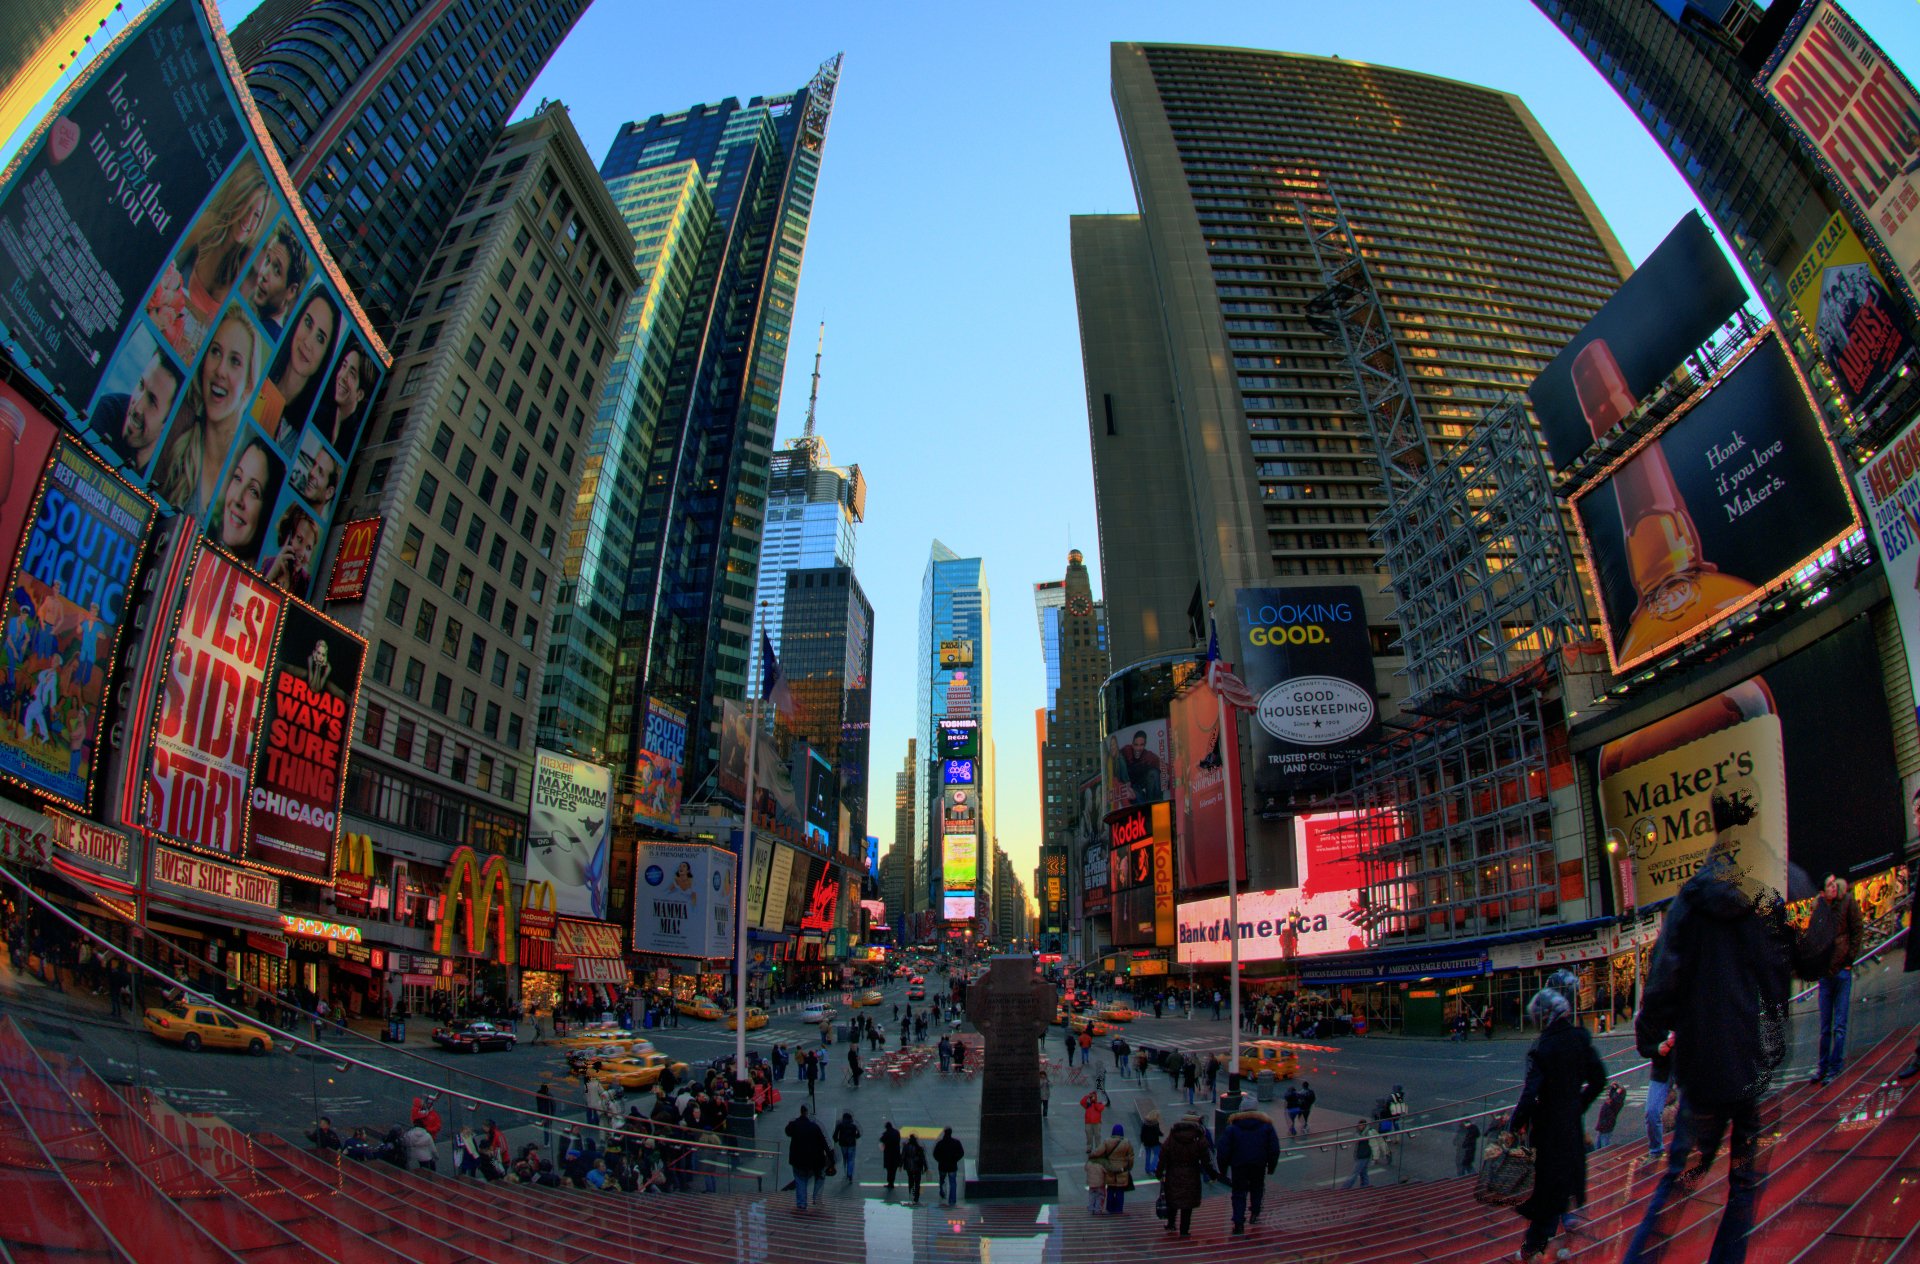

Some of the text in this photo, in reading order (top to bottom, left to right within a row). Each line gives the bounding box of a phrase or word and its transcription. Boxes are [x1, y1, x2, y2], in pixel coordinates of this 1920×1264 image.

[1821, 9, 1875, 70] THE MUSICAL
[1774, 21, 1865, 142] BILLY
[106, 73, 158, 174] he's just
[1822, 64, 1920, 211] ELLIOT
[89, 122, 145, 227] into you
[118, 149, 173, 236] not that
[1788, 252, 1816, 294] BEST
[1816, 215, 1844, 254] PLAY
[10, 277, 45, 339] February
[42, 321, 61, 352] 6th
[1853, 364, 1875, 394] OSAGE
[1871, 318, 1894, 360] COUNTY
[1705, 430, 1746, 470] Honk
[1715, 440, 1783, 497] if you love
[54, 462, 142, 540] BEST MUSICAL REVIVAL
[1723, 474, 1785, 523] Maker's.
[1875, 498, 1899, 530] 2008
[37, 487, 138, 585] SOUTH
[1881, 512, 1914, 563] BEST
[22, 526, 126, 627] PACIFIC
[340, 569, 359, 583] 24
[180, 548, 282, 672] WEST
[1246, 603, 1352, 625] LOOKING
[1248, 625, 1331, 646] GOOD.
[158, 638, 262, 767] SIDE
[277, 671, 345, 718] BROAD
[1264, 702, 1368, 718] HOUSEKEEPING
[1268, 687, 1289, 703] LIMITED
[1290, 681, 1321, 690] WARRANTY
[1293, 690, 1334, 702] GOOD
[276, 692, 343, 742] WAY'S
[647, 713, 686, 746] SOUTH
[940, 720, 977, 728] TOSHIBA
[1268, 720, 1306, 739] REPLACEMENT
[270, 718, 339, 770] SURE
[645, 730, 684, 765] PACIFIC
[1268, 753, 1308, 764] TRUSTED
[1308, 752, 1327, 760] FOR
[22, 751, 51, 771] CENTER
[53, 766, 86, 785] THEATER
[266, 747, 335, 803] THING
[540, 756, 575, 774] maxell
[540, 767, 574, 783] WHERE
[1283, 764, 1308, 775] (AND
[1623, 751, 1754, 818] Maker's
[146, 746, 243, 855] STORY
[536, 793, 577, 813] LIVES
[537, 785, 607, 809] PERFORMANCE
[538, 774, 607, 802] MAXIMUM
[252, 787, 335, 832] CHICAGO
[1112, 811, 1147, 847] Kodak
[79, 824, 124, 866] STORY
[1648, 850, 1707, 871] KENTUCKY STRAIGHT
[161, 853, 272, 905] WEST SIDE STORY
[336, 877, 368, 891] McDonald's
[1154, 841, 1170, 909] Kodak
[1621, 862, 1630, 905] WELCOME
[521, 912, 554, 923] McDonald's
[653, 901, 688, 920] MAMMA
[660, 918, 681, 935] MIA!
[300, 939, 326, 952] SHOP
[1179, 921, 1206, 944] Bank
[1208, 920, 1219, 941] of
[1303, 957, 1483, 978] AMERICAN EAGLE OUTFITTERS AMERICAN EAGLE OUTFITTERS
